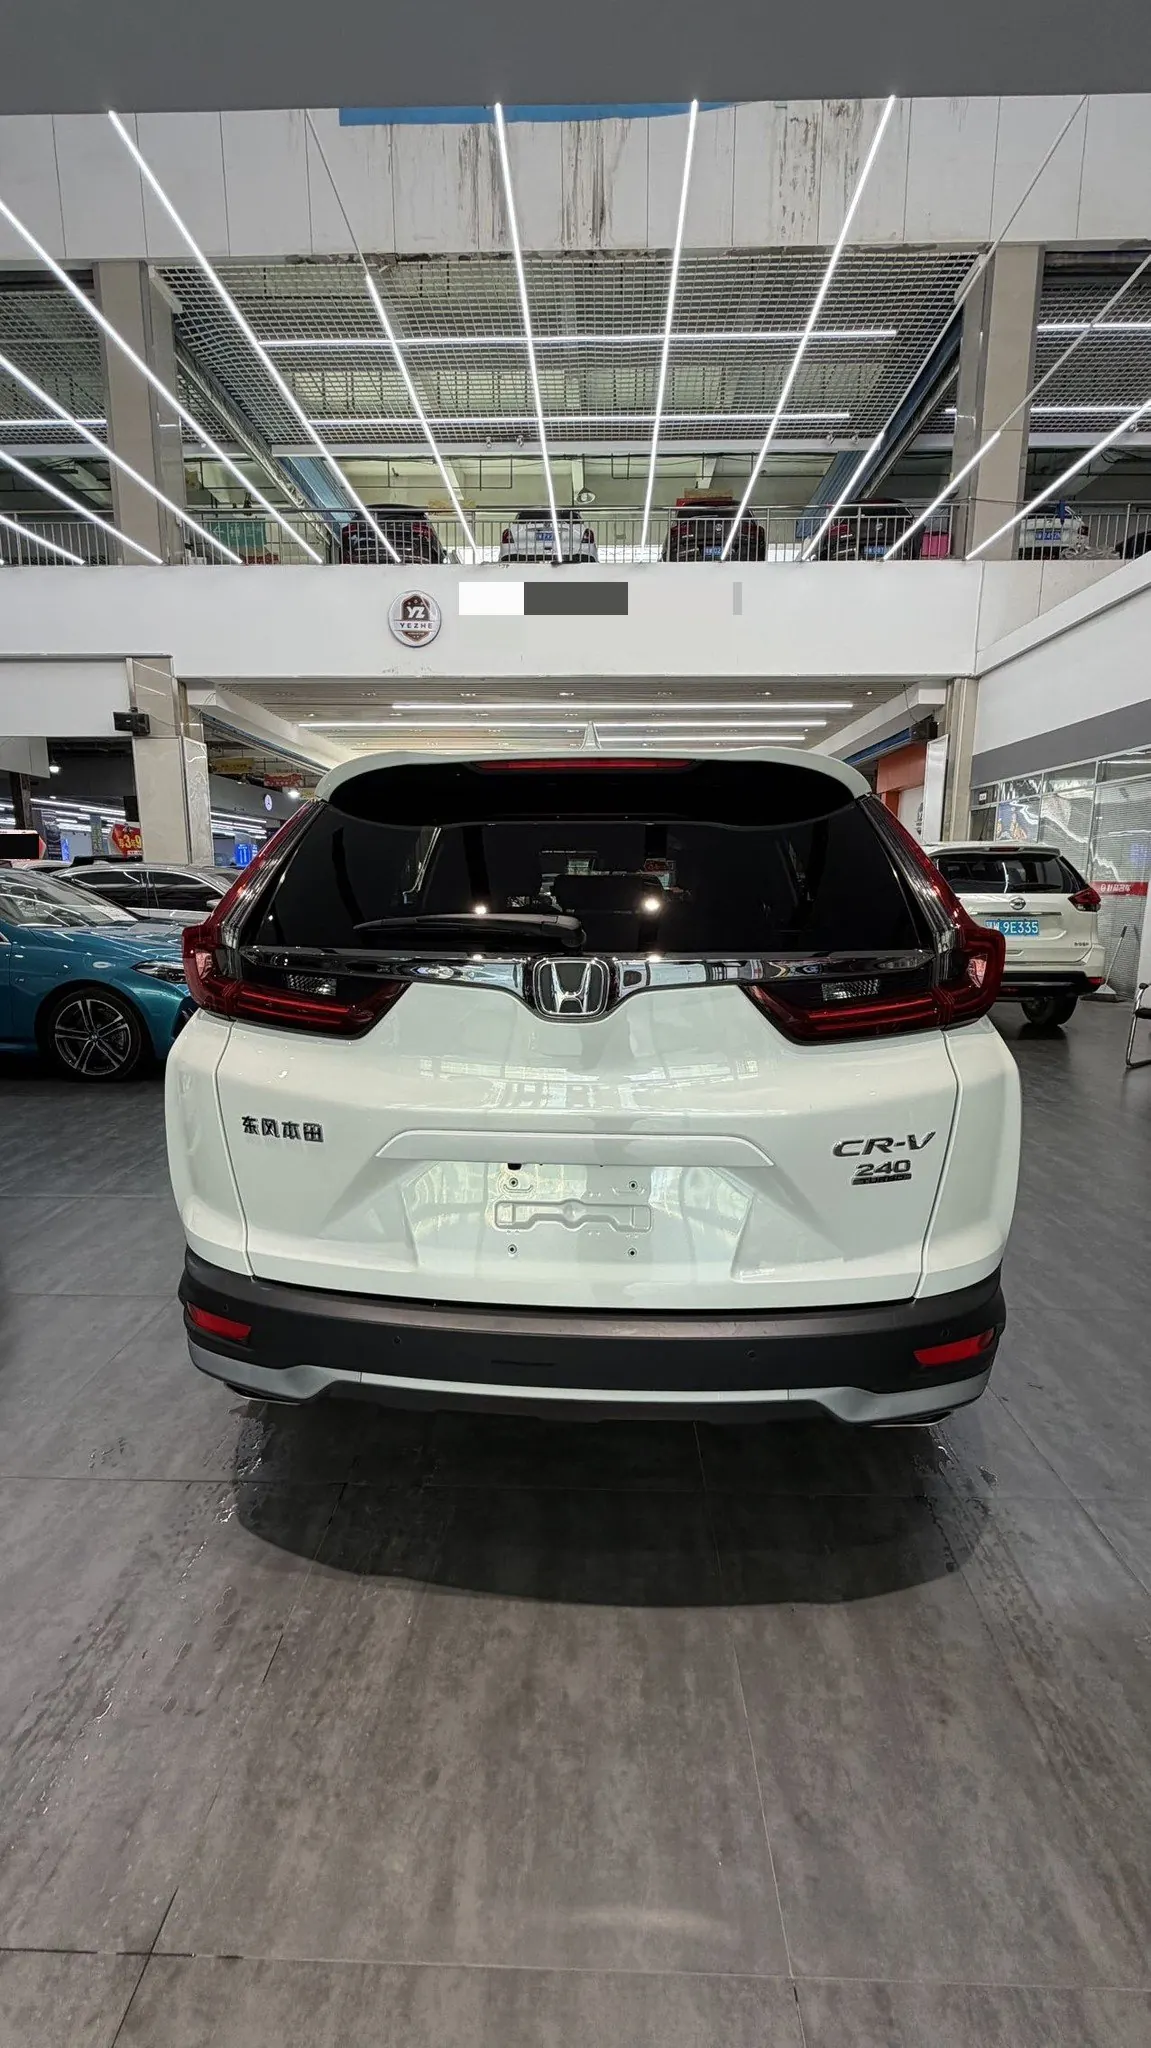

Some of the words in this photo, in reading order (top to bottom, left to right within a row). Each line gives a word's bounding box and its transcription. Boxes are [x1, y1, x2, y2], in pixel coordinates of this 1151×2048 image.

[242, 1116, 324, 1143] 东风本田
[833, 1131, 936, 1157] CR-V
[855, 1159, 911, 1177] 240
